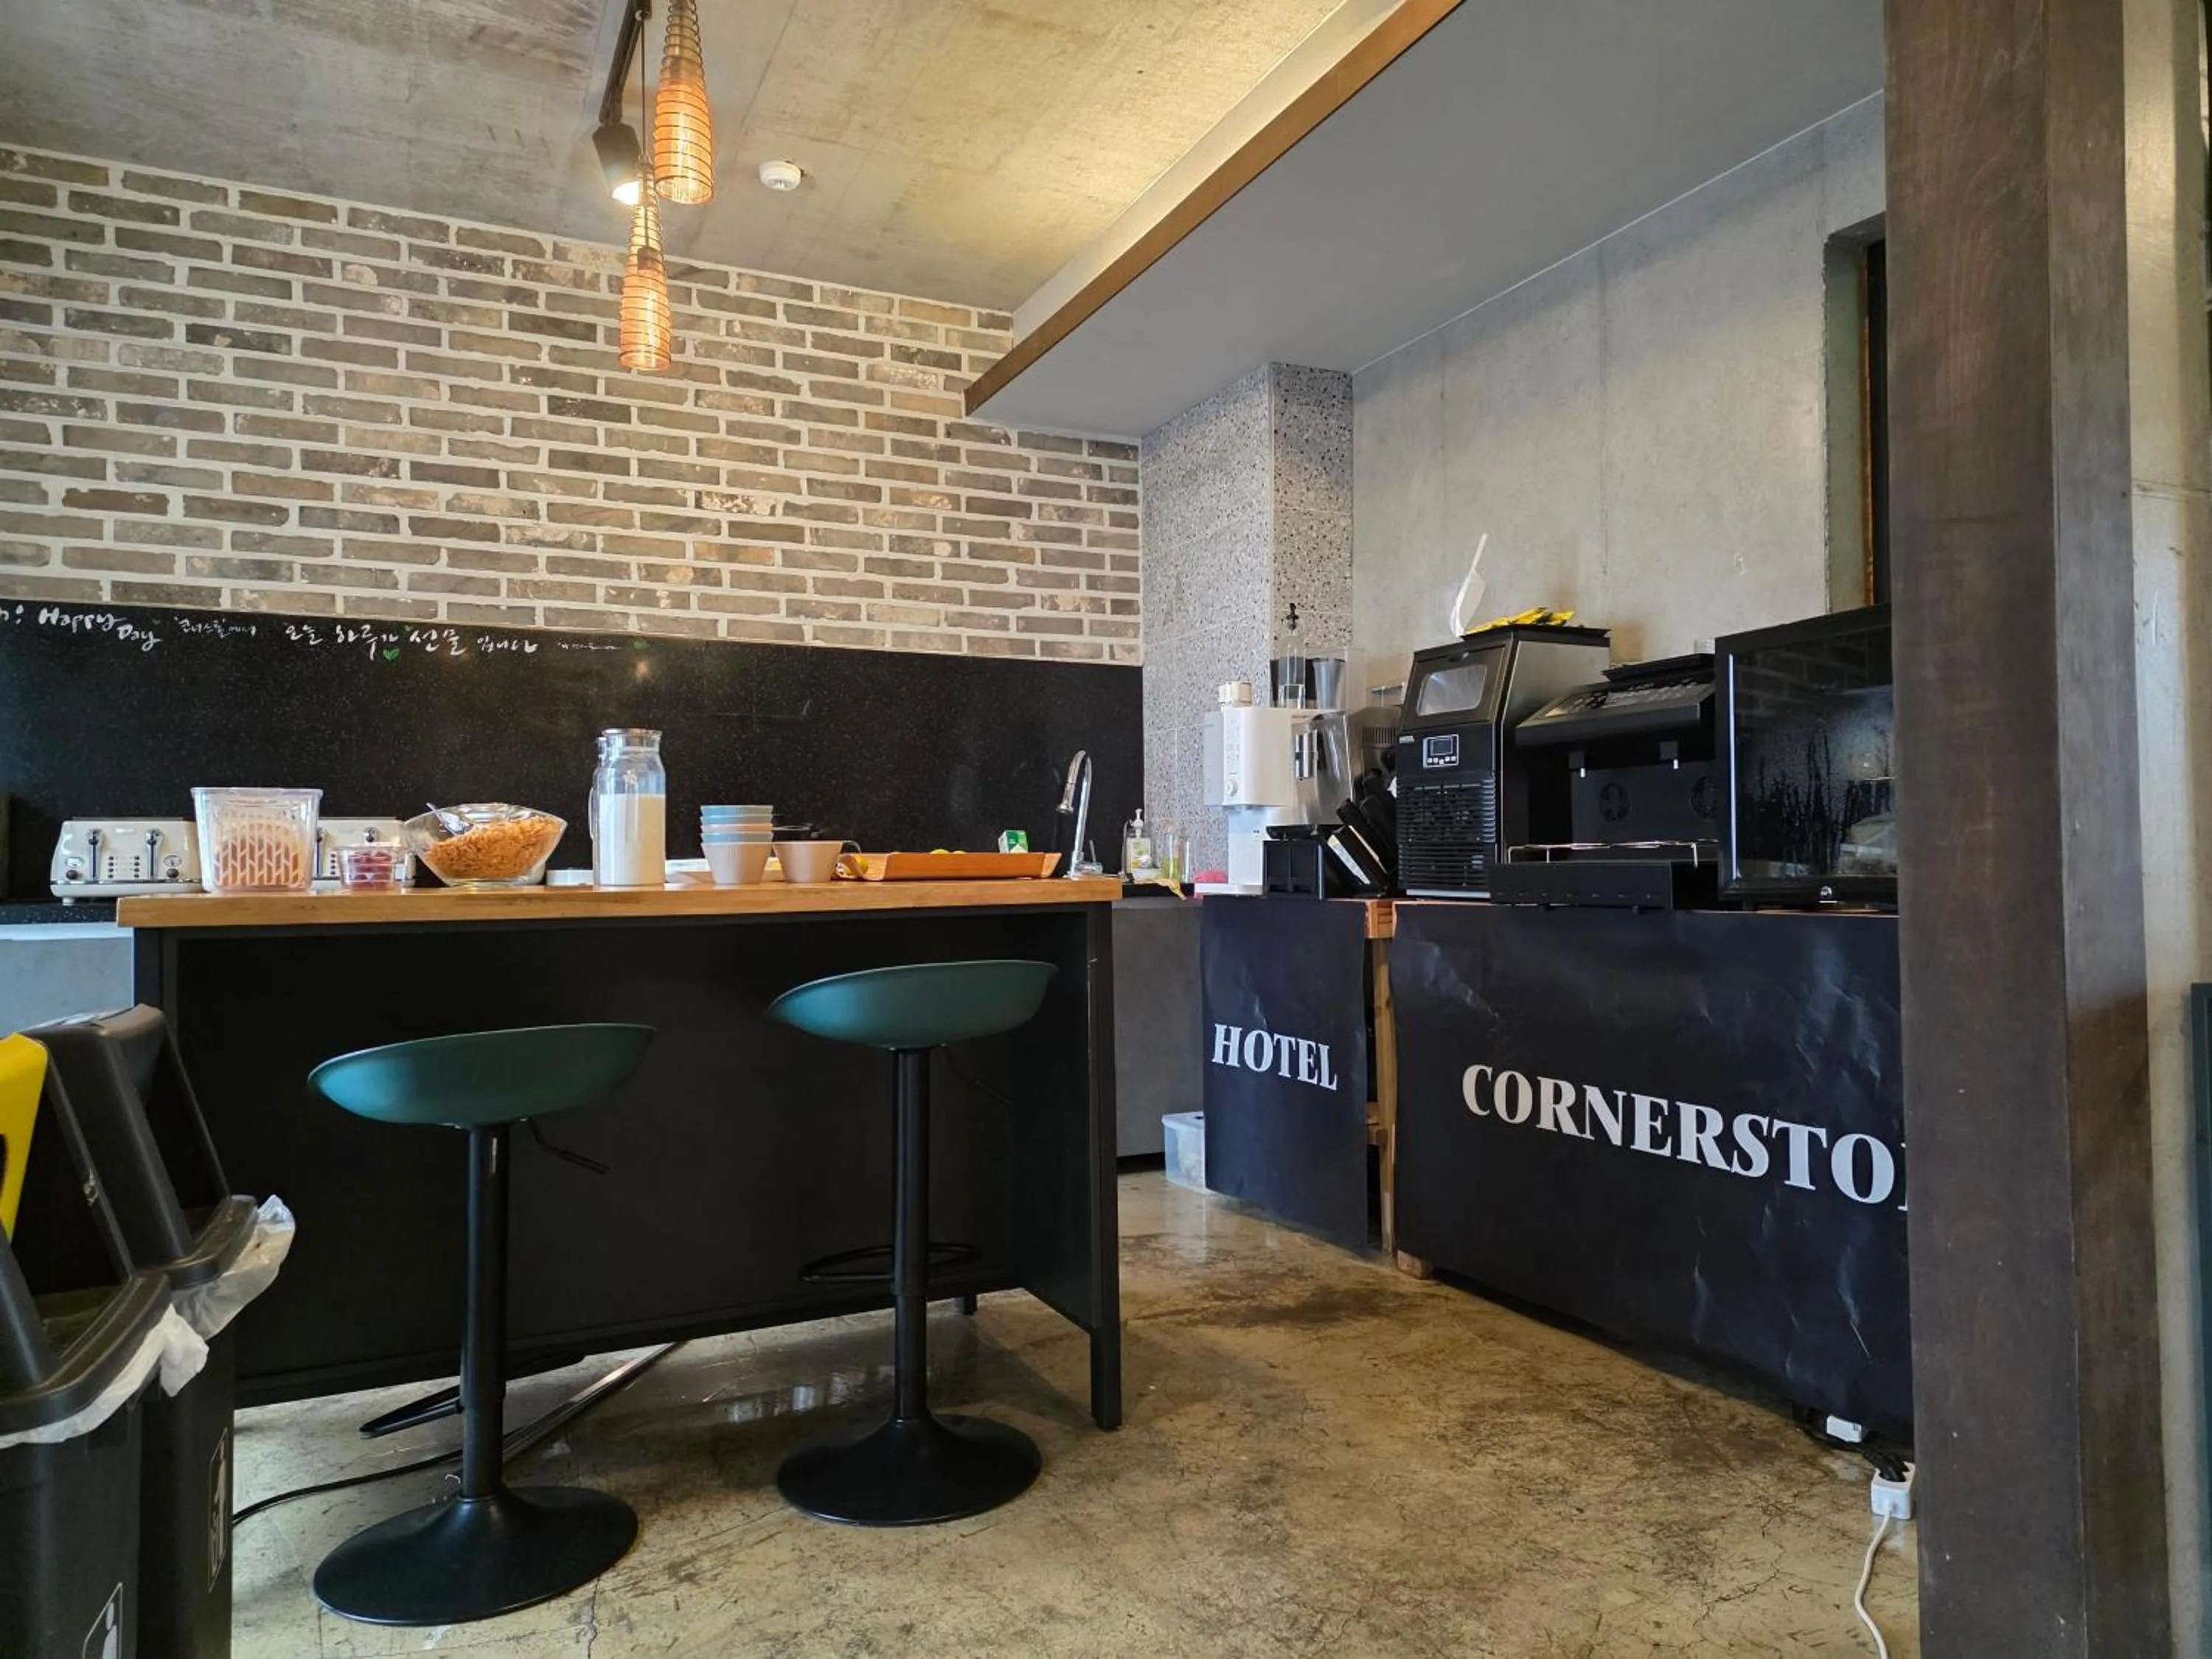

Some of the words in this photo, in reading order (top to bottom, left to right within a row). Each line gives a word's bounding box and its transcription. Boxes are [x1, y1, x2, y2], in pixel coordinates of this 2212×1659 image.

[38, 608, 127, 633] Happy
[117, 623, 162, 652] Day
[1212, 1023, 1338, 1091] HOTEL
[1462, 1064, 1907, 1211] CORNERSTO
